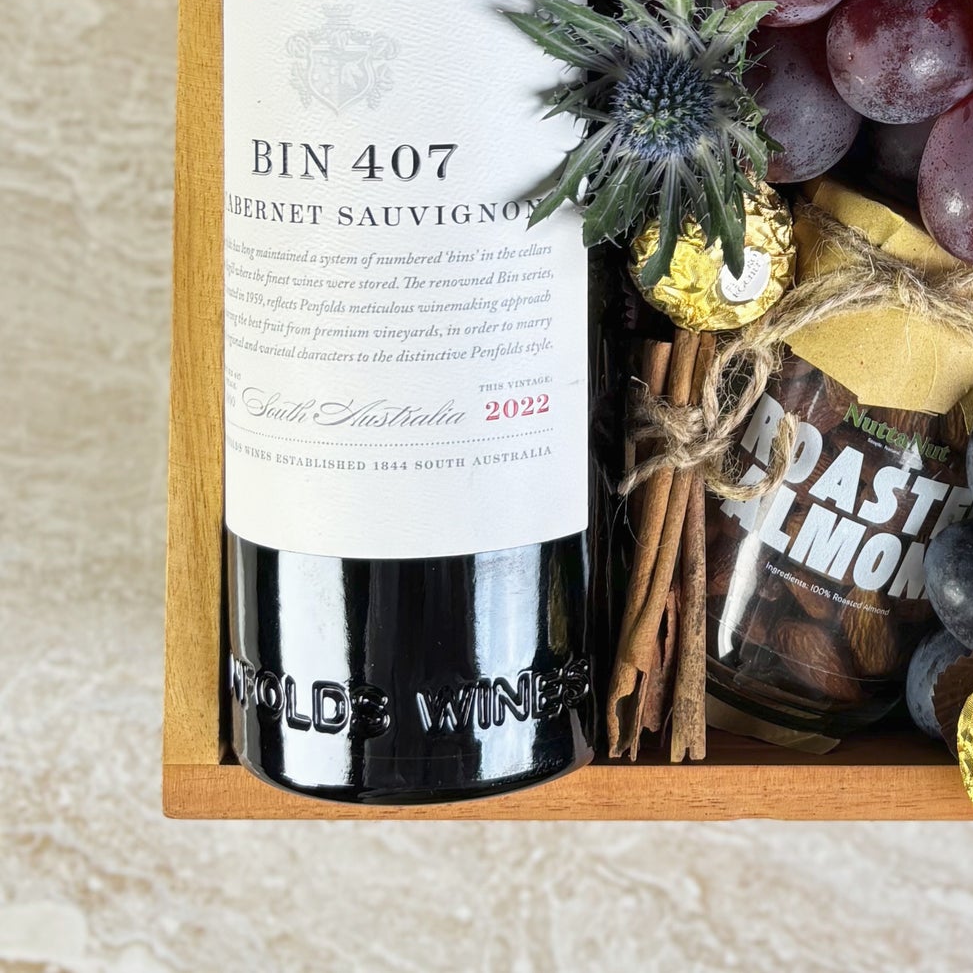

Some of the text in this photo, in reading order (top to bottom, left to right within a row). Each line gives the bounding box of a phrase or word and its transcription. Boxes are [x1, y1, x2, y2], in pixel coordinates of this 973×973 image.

[252, 138, 459, 183] BIN 407
[226, 192, 323, 225] ABERNET
[256, 247, 308, 263] maintained
[310, 254, 317, 263] a
[319, 255, 357, 268] system
[361, 253, 376, 269] of
[376, 250, 443, 265] numbered
[480, 250, 494, 262] in
[497, 247, 516, 260] the
[518, 244, 553, 258] cellars
[264, 271, 290, 286] finest
[292, 275, 324, 288] wines
[326, 278, 356, 289] were
[358, 276, 399, 290] stored.
[403, 276, 428, 289] The
[429, 272, 495, 288] renowned
[497, 270, 519, 284] Bin
[521, 267, 554, 282] series,
[246, 291, 266, 307] 1959,
[266, 295, 297, 312] reflects
[299, 298, 346, 316] Penfolds
[348, 301, 414, 314] meticulous
[417, 297, 498, 314] winemaking
[500, 290, 552, 312] approach
[262, 318, 285, 334] fruit
[284, 321, 311, 338] from
[312, 325, 369, 341] premium
[372, 324, 444, 343] vineyards,
[446, 323, 461, 336] in
[464, 321, 500, 335] order
[501, 320, 514, 332] to
[516, 316, 553, 331] marry
[259, 342, 296, 358] varietal
[297, 346, 354, 363] characters
[357, 351, 369, 363] to
[372, 349, 393, 363] the
[395, 346, 467, 363] distinctive
[470, 341, 524, 362] Penfolds
[525, 337, 554, 356] style.
[479, 382, 504, 392] THIS
[241, 386, 317, 423] South
[312, 398, 466, 427] Australia
[485, 393, 550, 421] 2022
[843, 402, 951, 463] NuttaNut
[276, 453, 366, 471] ESTABLISHED
[373, 461, 408, 471] 1844
[414, 459, 466, 470] SOUTH
[472, 445, 553, 467] AUSTRALIA
[719, 463, 928, 600] ALMON
[810, 584, 831, 599] 100%
